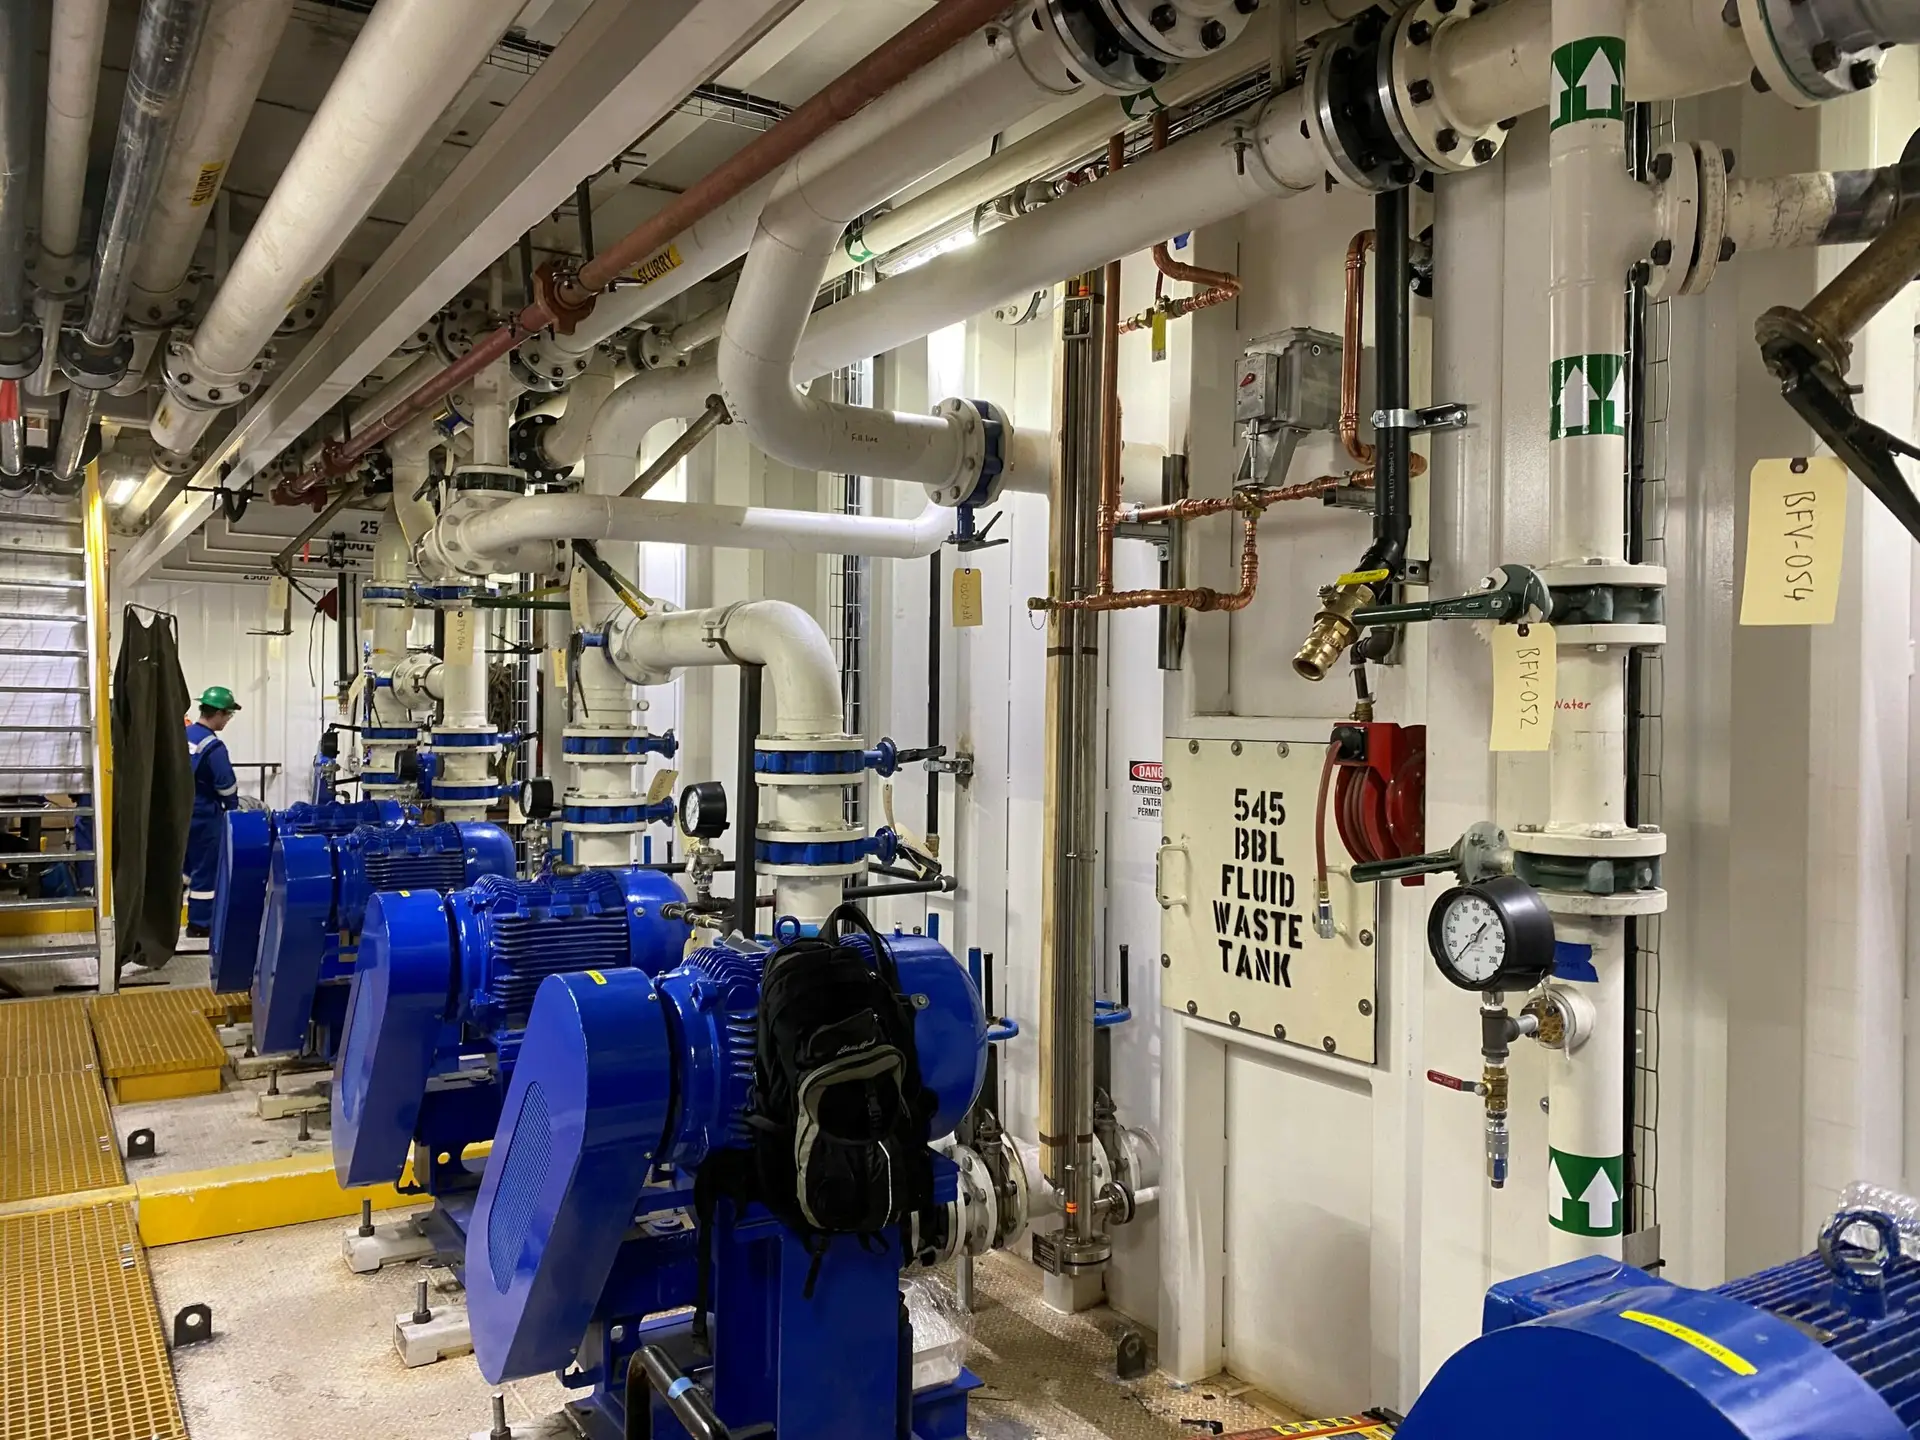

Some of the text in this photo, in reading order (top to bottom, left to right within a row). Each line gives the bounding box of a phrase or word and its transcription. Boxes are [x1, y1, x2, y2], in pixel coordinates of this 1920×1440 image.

[637, 248, 676, 285] SLURRY
[1783, 491, 1816, 601] BFV-054
[1516, 647, 1541, 730] BFV-052
[1132, 784, 1162, 796] CONFINED
[1142, 797, 1162, 808] ENTER
[1234, 788, 1286, 826] 545
[1137, 807, 1160, 818] PERMIT
[1234, 827, 1285, 866] BBL
[1221, 863, 1295, 908] FLUID
[1212, 900, 1303, 950] WASTE
[1482, 908, 1491, 916] 120
[1490, 918, 1499, 926] 140
[1218, 939, 1292, 988] TANK
[1488, 956, 1498, 964] 200
